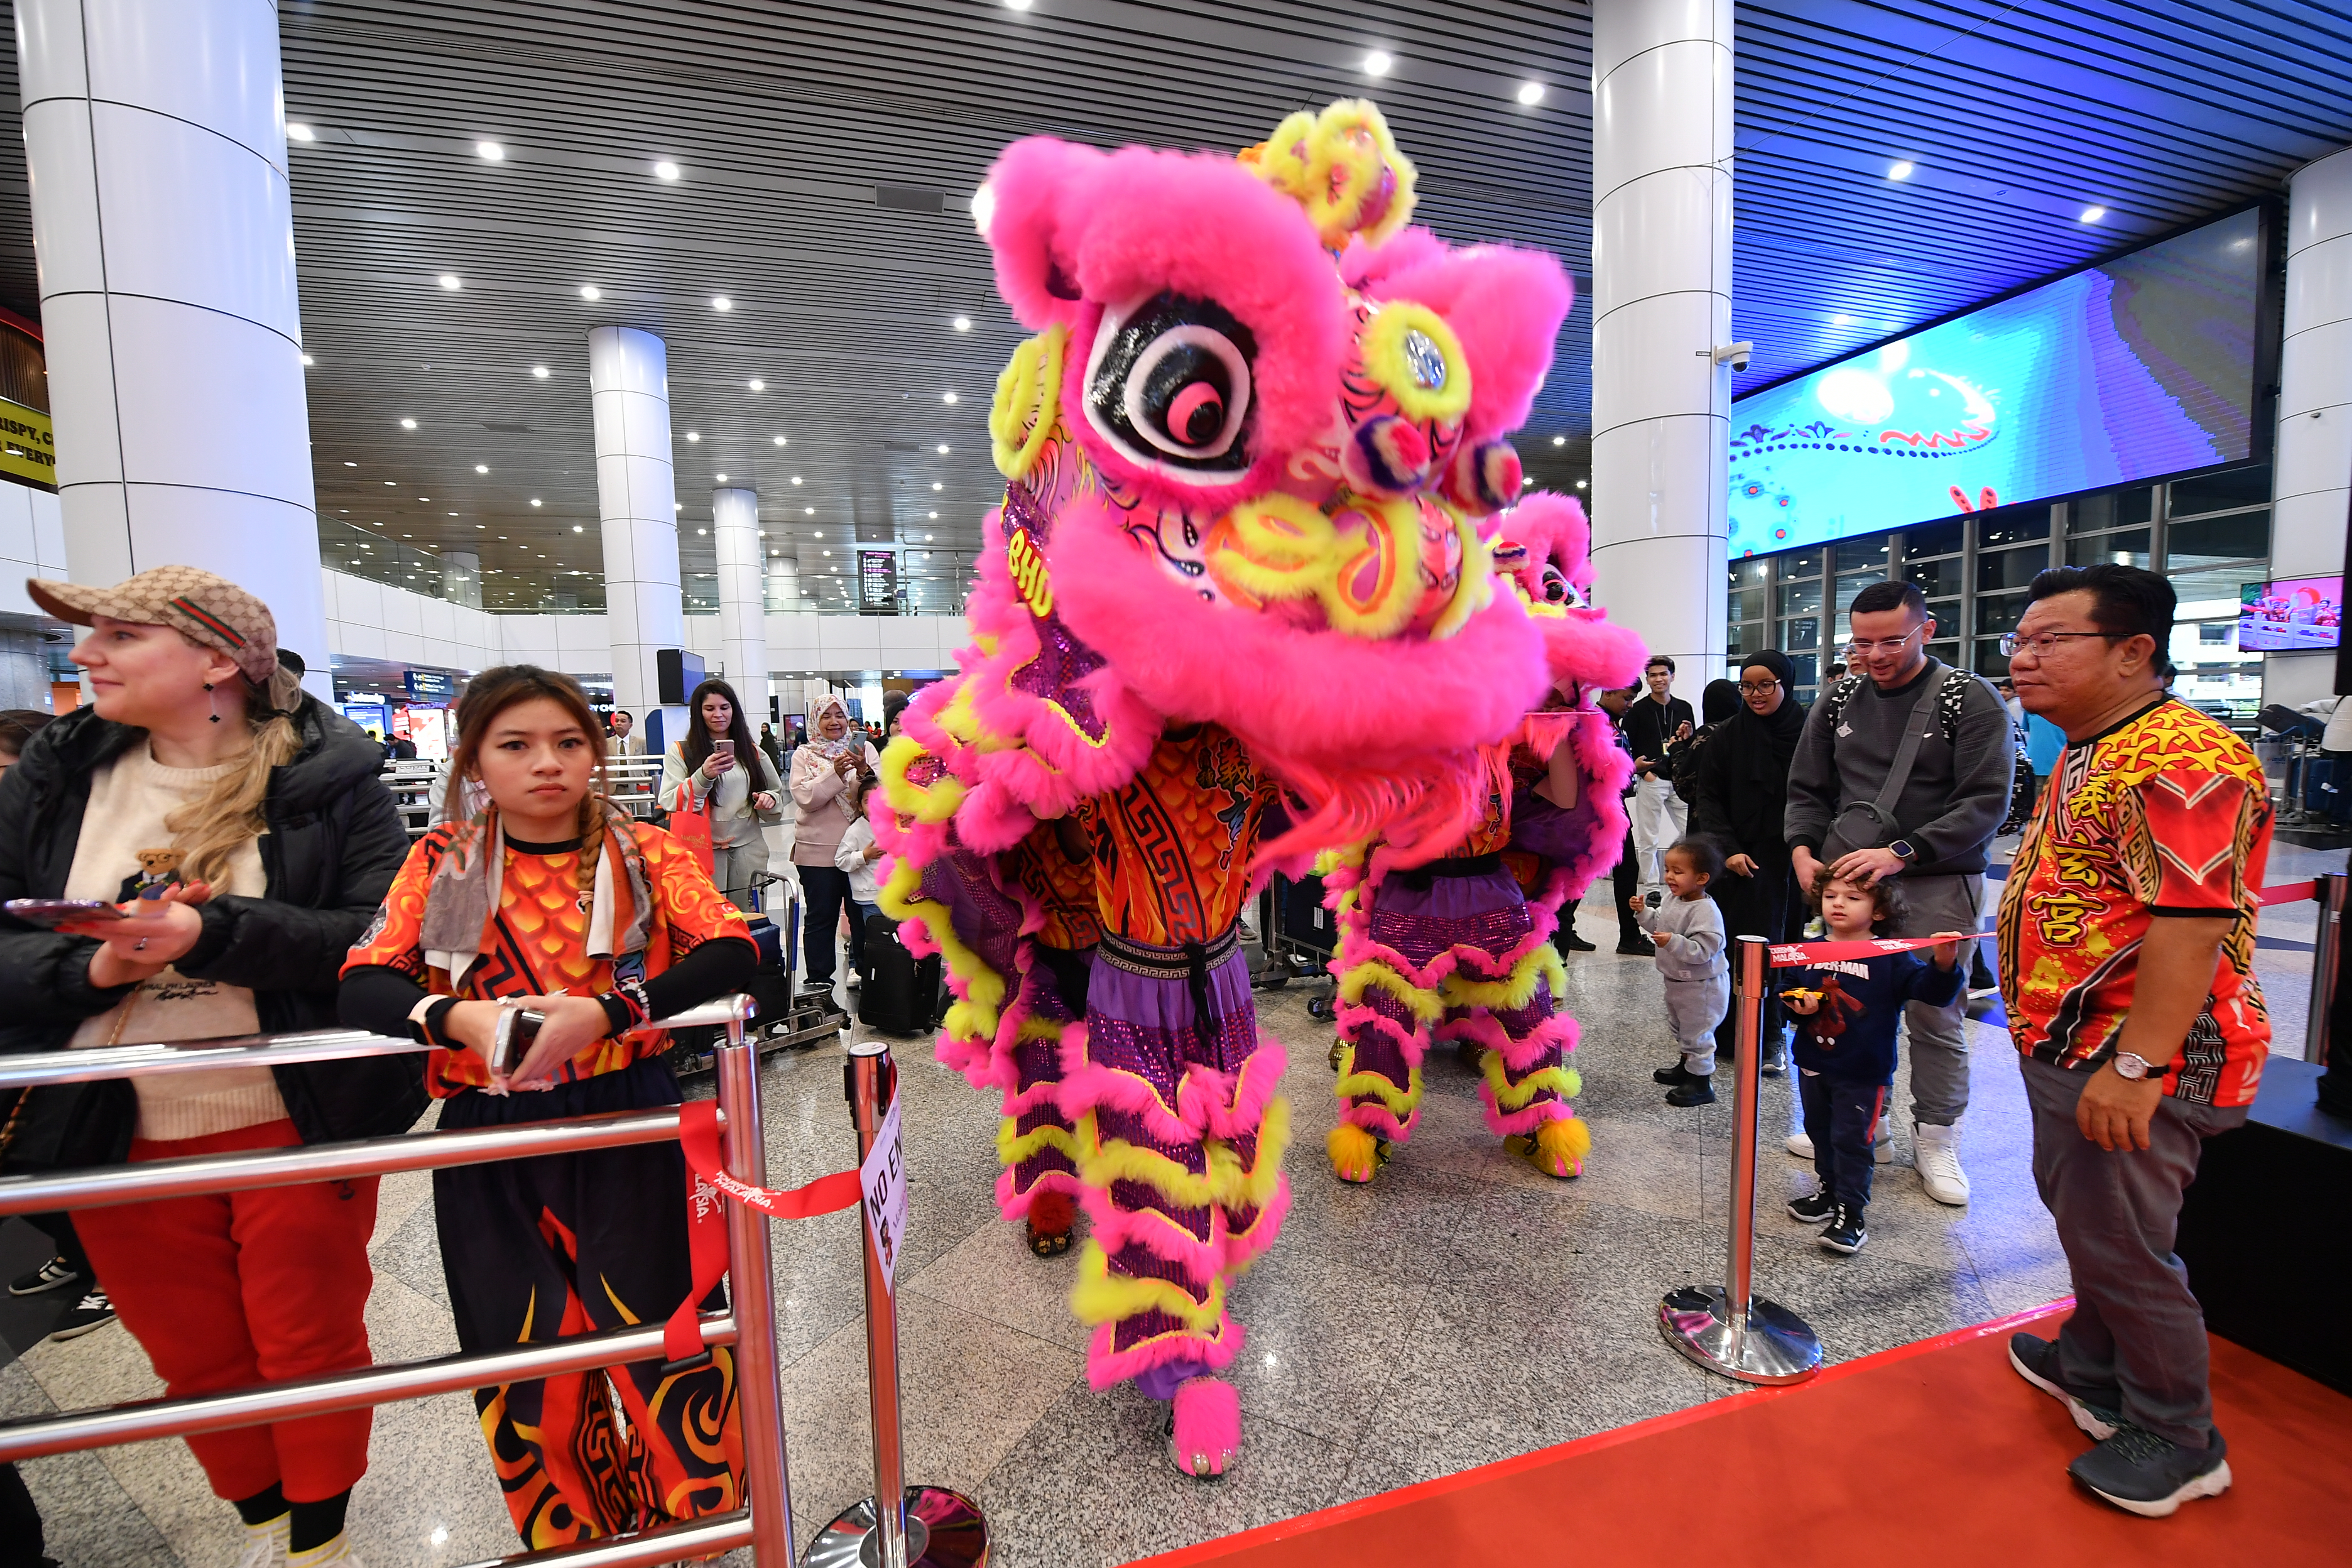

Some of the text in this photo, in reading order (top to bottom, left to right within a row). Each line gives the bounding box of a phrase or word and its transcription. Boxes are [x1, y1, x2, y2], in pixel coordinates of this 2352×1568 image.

[7, 441, 56, 466] EVERY
[870, 1169, 888, 1229] NO
[888, 1118, 902, 1183] EN
